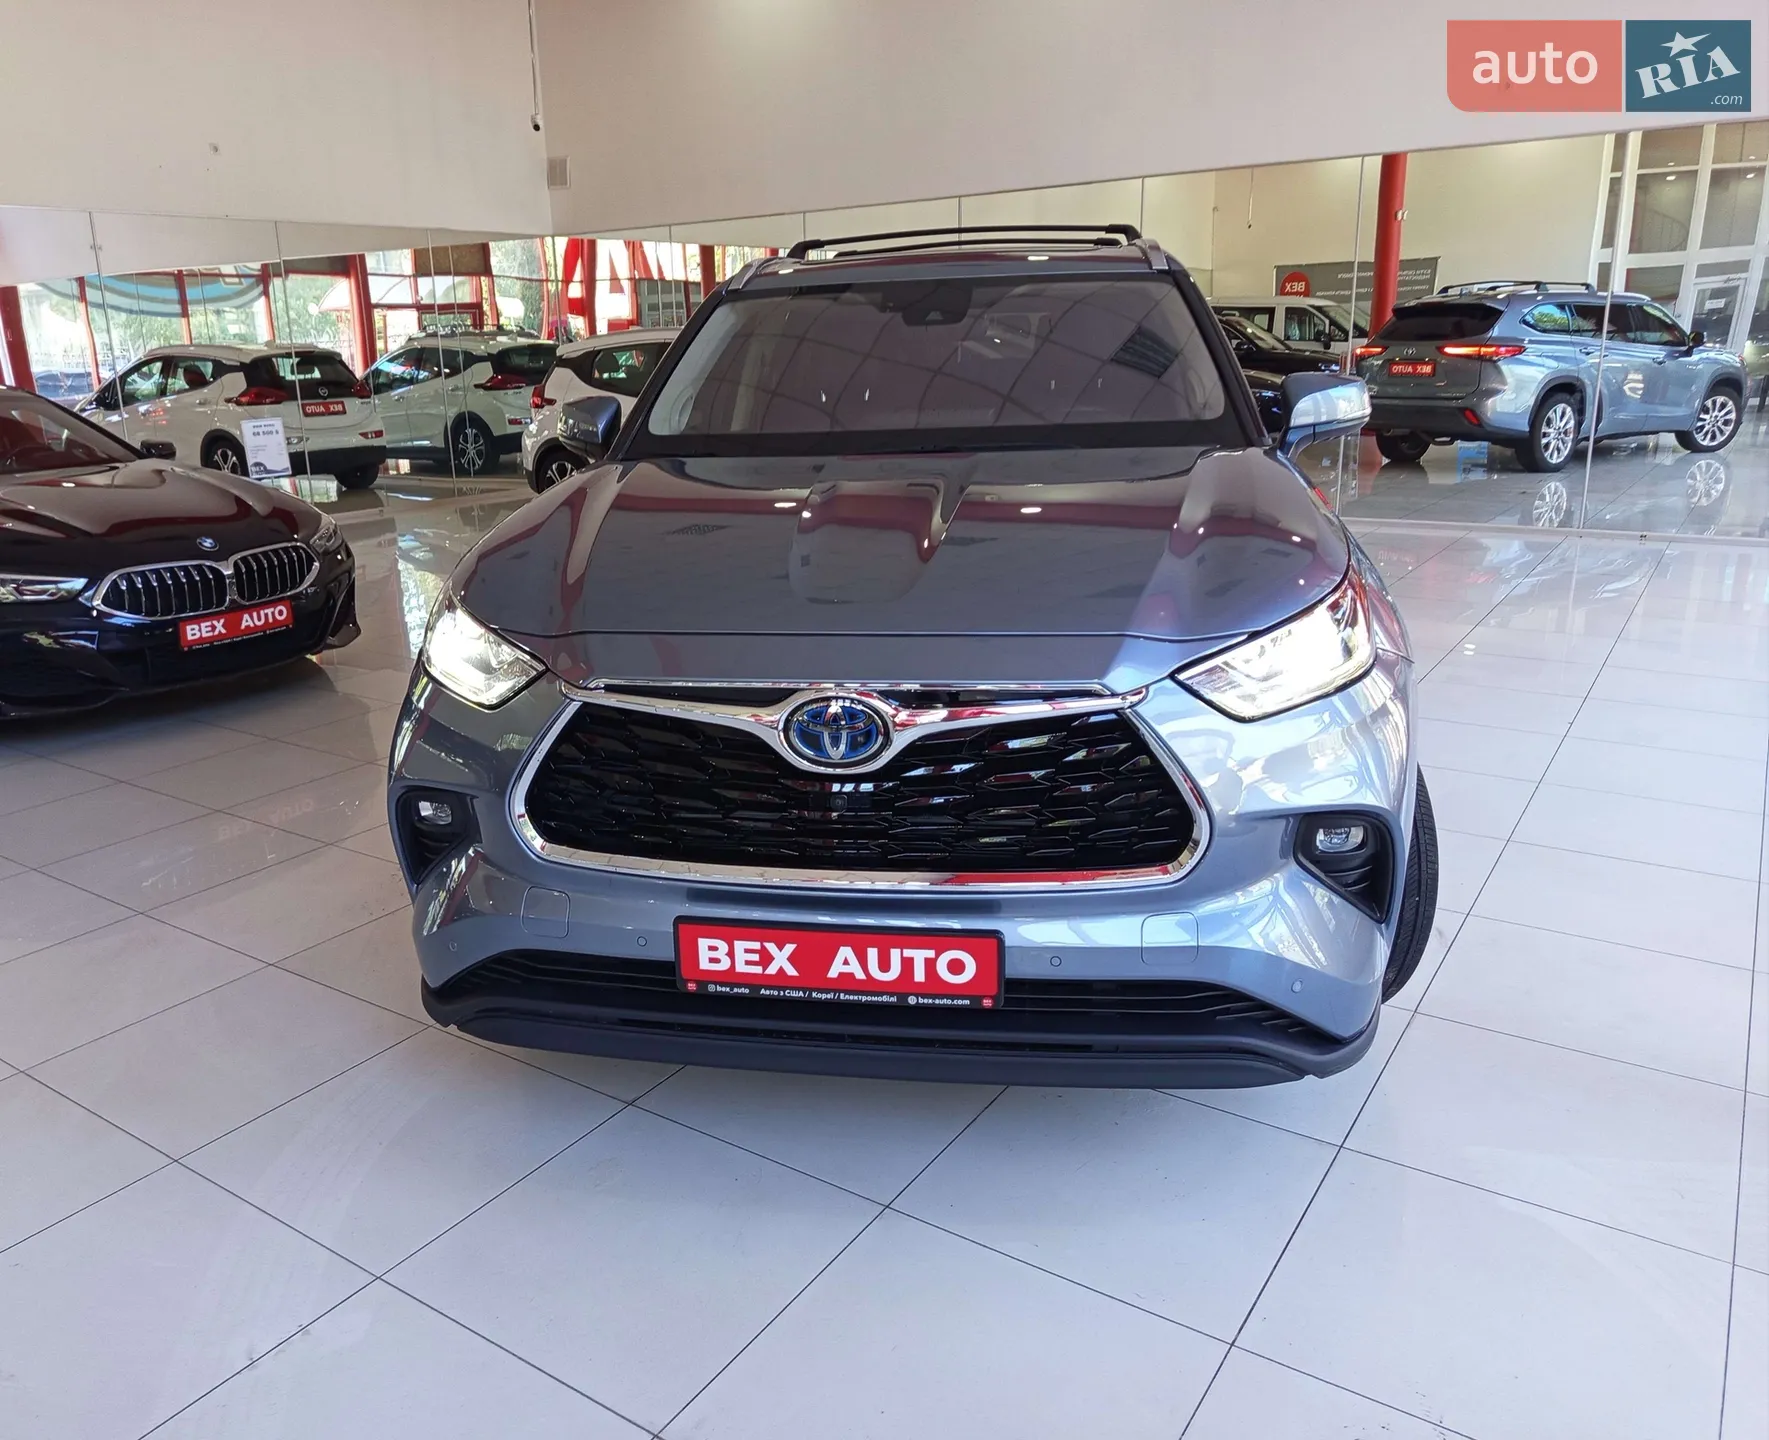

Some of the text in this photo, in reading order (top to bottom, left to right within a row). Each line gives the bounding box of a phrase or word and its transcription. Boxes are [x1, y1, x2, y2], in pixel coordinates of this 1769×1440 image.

[186, 619, 227, 641] BEX
[240, 605, 287, 630] AUTO
[697, 937, 977, 984] BEX AUTO
[716, 985, 750, 994] bex_auto
[760, 988, 779, 996] Авто
[785, 990, 804, 998] США
[840, 993, 897, 1003] Електромобілі
[918, 996, 970, 1006] bex-auto.com
